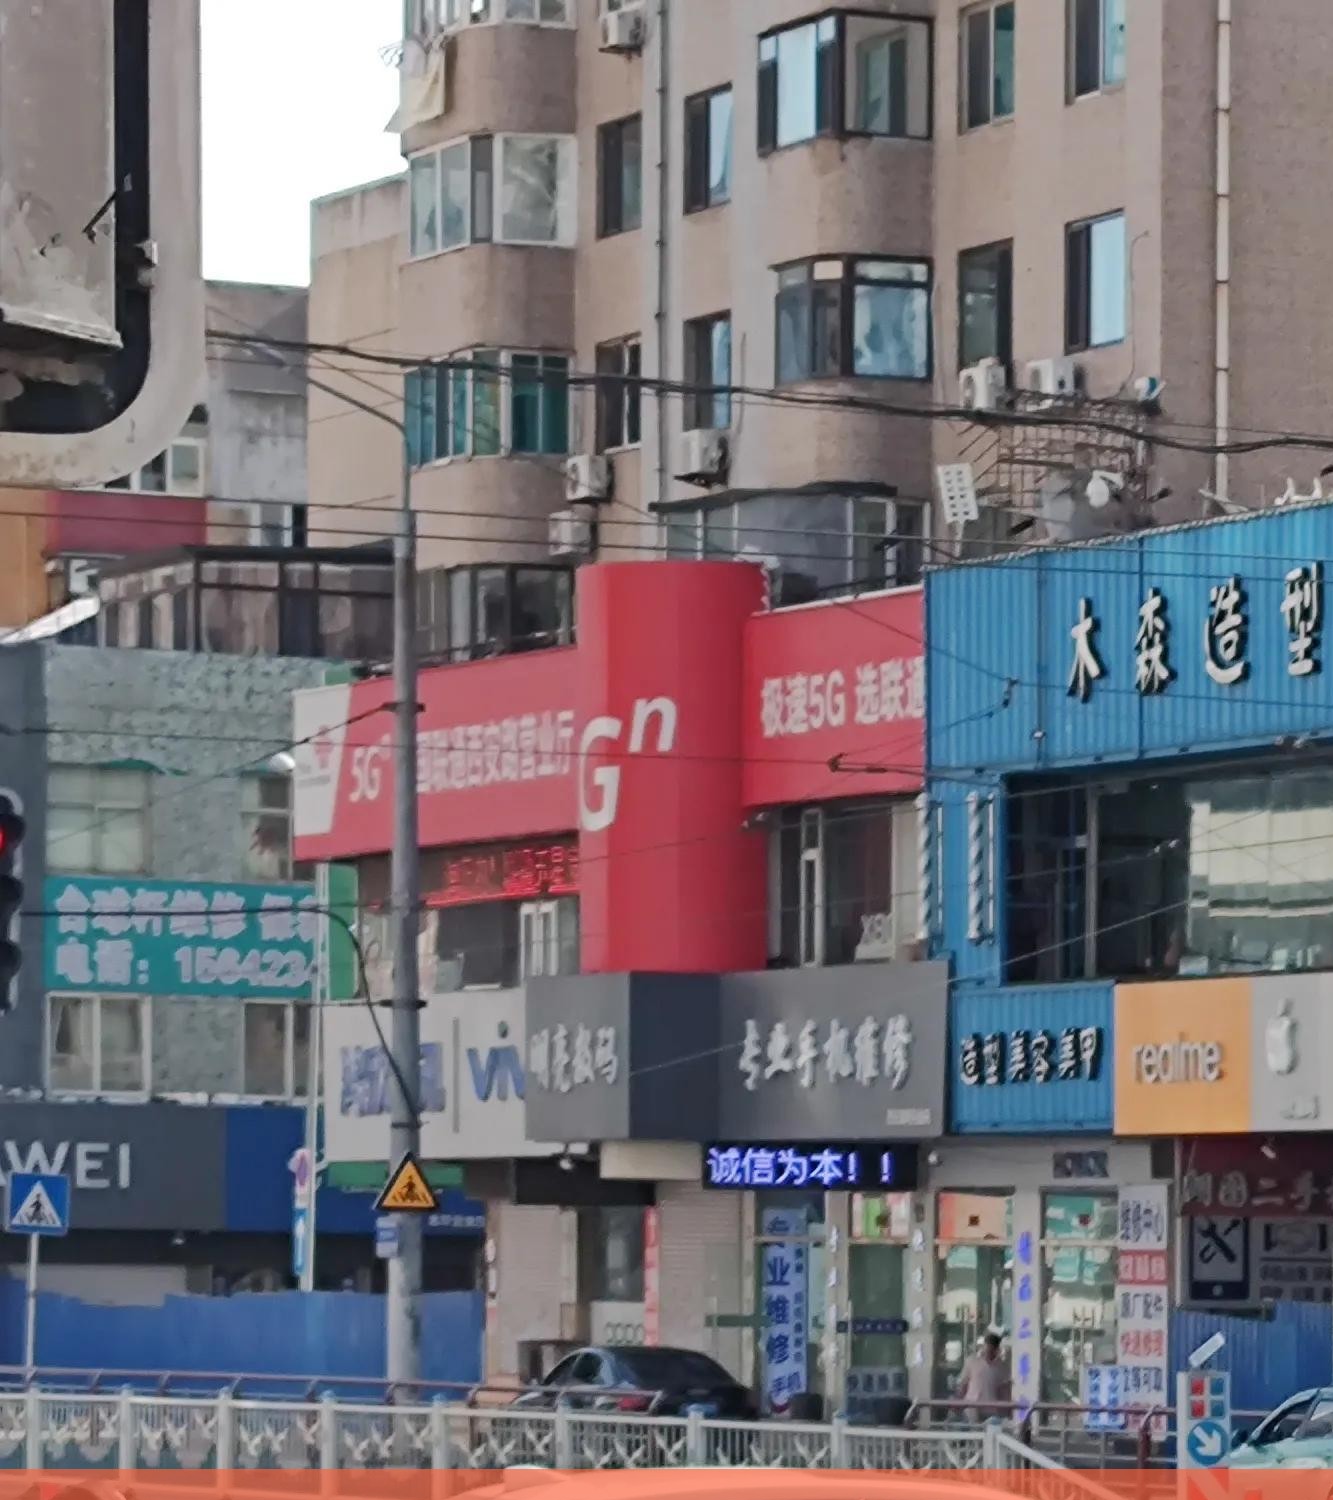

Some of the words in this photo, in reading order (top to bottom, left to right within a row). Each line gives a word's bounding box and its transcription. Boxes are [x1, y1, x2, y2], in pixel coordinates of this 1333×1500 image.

[1063, 559, 1322, 702] 木森造型
[0, 1138, 132, 1190] WEI
